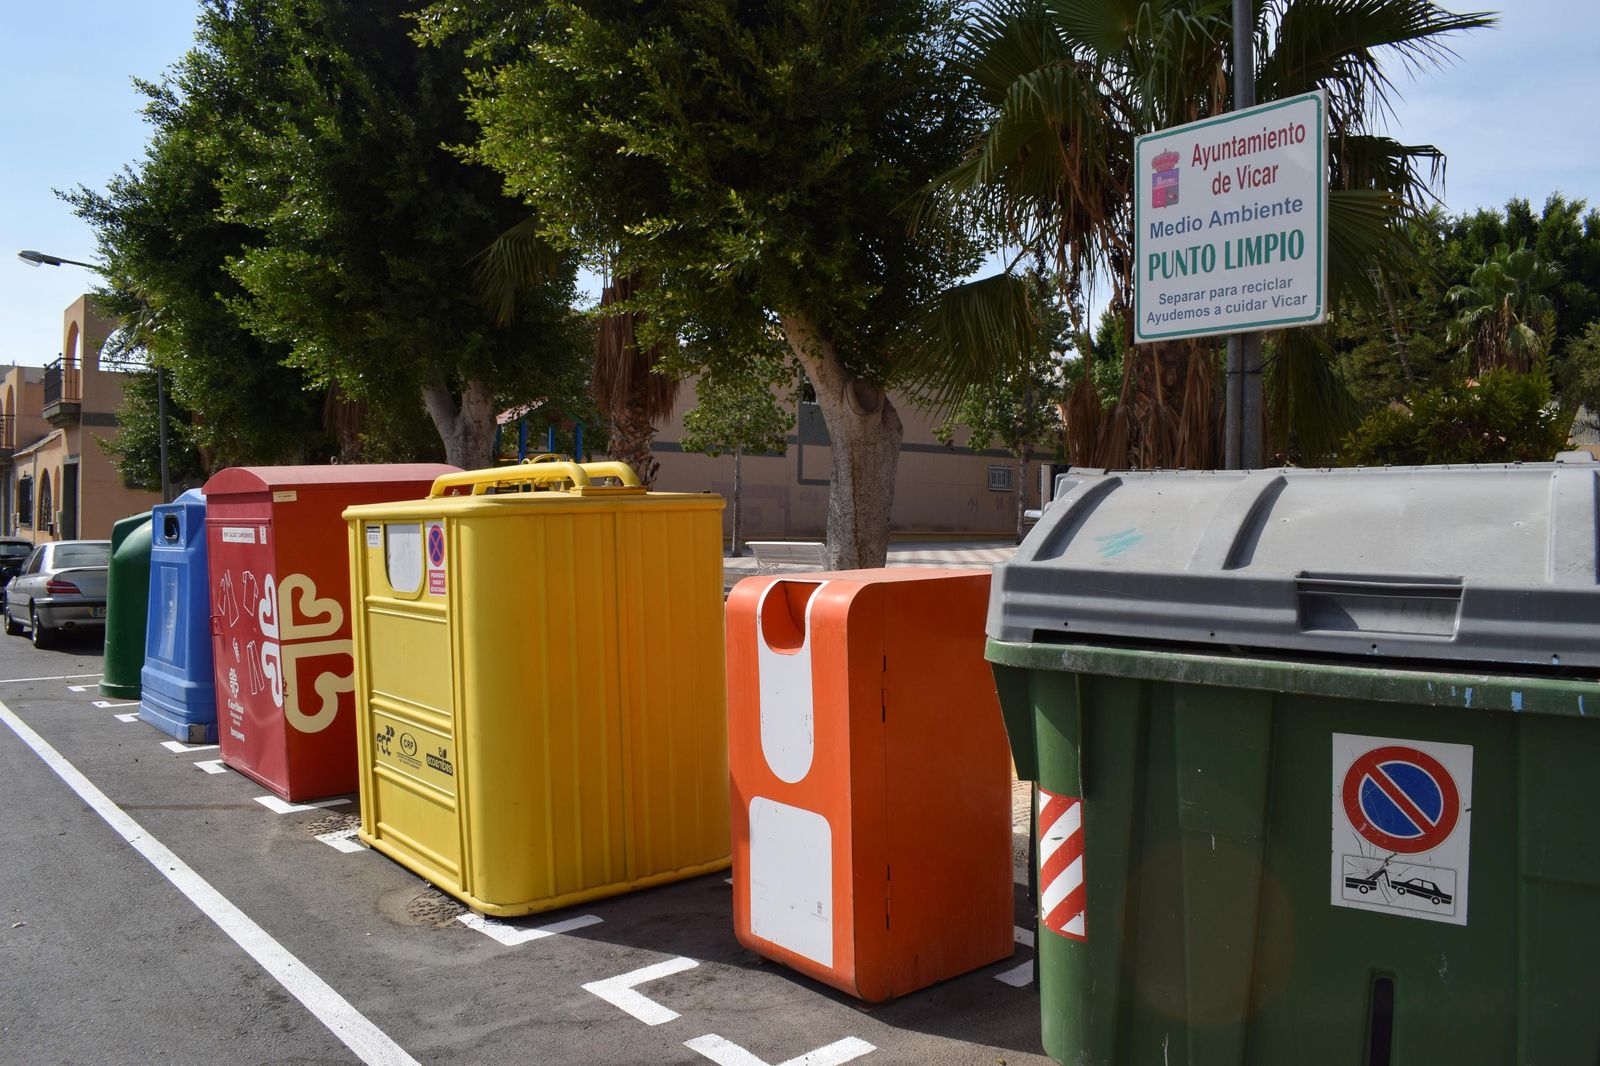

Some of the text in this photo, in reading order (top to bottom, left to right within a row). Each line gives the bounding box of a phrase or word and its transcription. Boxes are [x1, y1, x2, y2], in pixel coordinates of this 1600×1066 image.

[1191, 122, 1305, 171] Ayuntamiento
[1212, 171, 1231, 196] de
[1150, 198, 1303, 239] Medio Ambiente
[1148, 229, 1305, 281] PUNTO LIMPIO
[1159, 276, 1294, 306] Separar para reciclar
[1147, 306, 1210, 326] Ayudemos
[1214, 305, 1222, 315] a
[1225, 297, 1268, 314] cuidar
